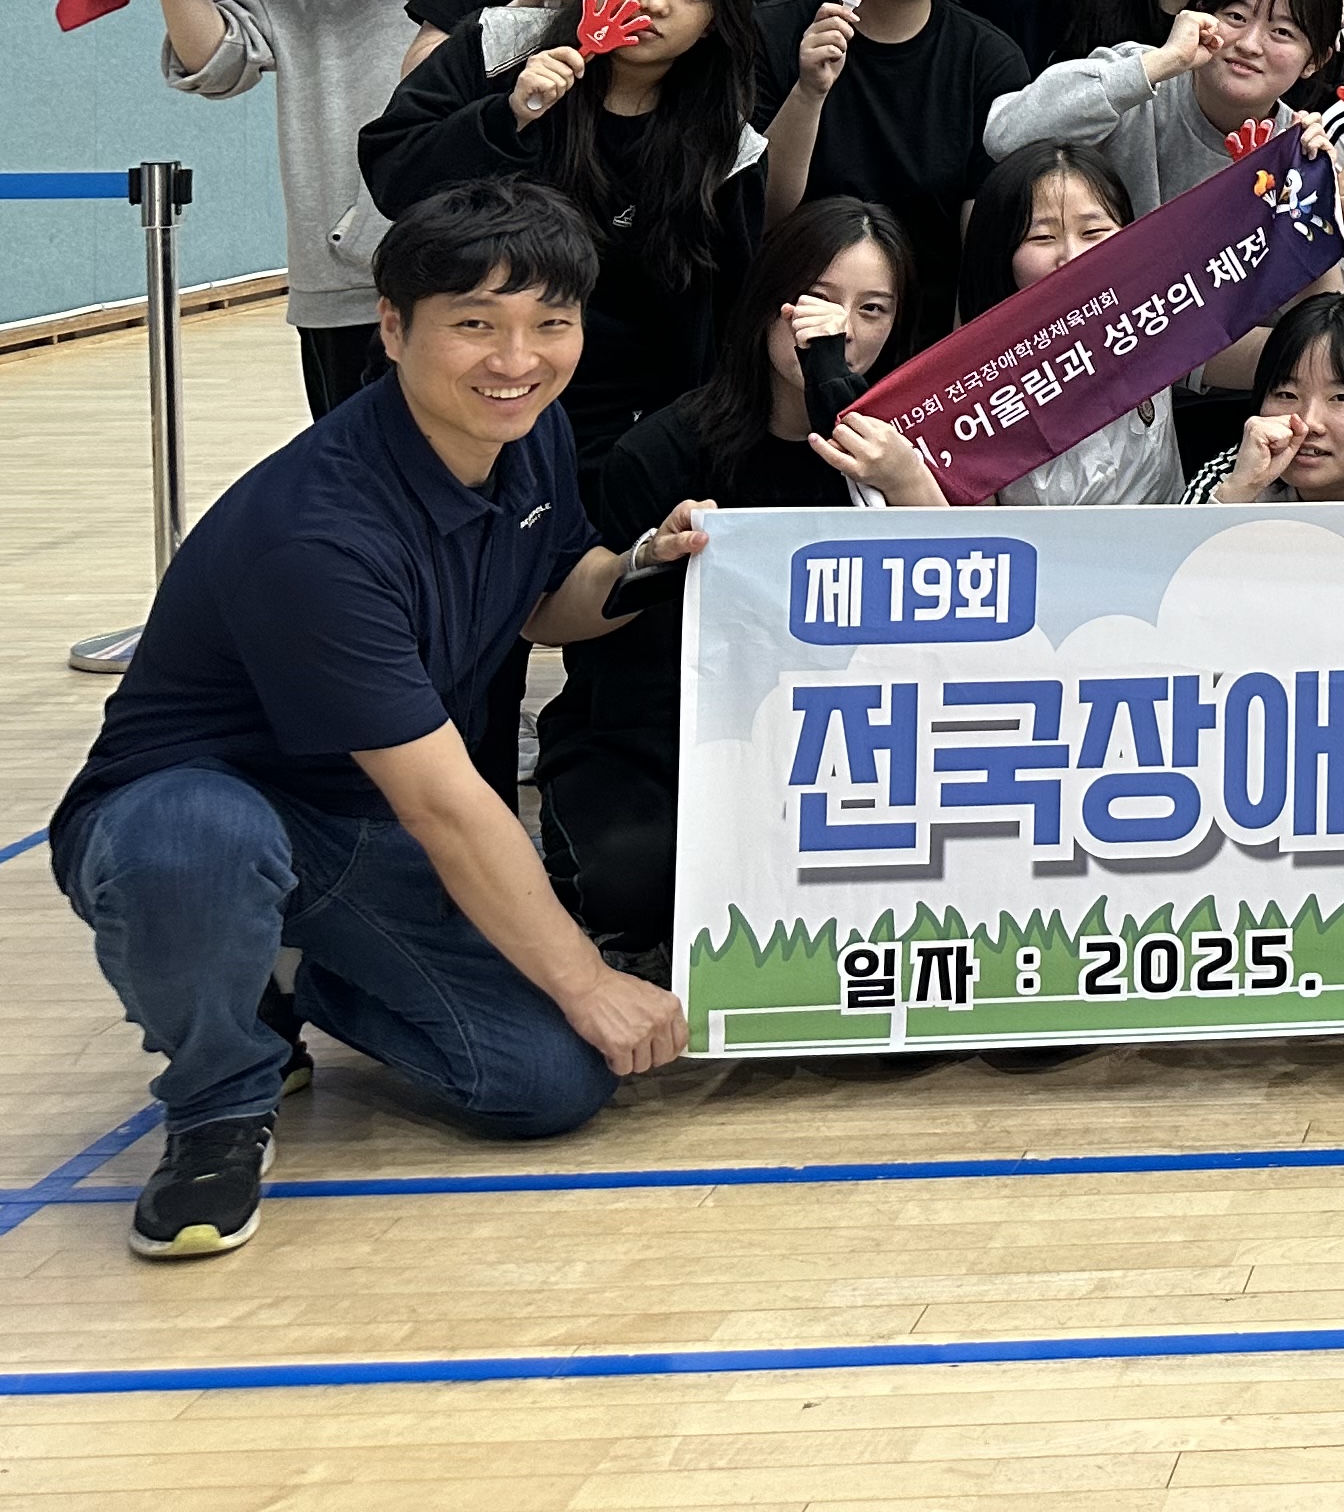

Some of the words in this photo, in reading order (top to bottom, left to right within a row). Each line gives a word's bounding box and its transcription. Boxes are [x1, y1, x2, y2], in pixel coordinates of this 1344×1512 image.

[945, 287, 1120, 404] 전국장애학생체육대회
[953, 339, 1097, 443] 어울림과
[1102, 272, 1206, 357] 성장의
[1205, 226, 1271, 290] 체전
[804, 557, 863, 628] 제
[882, 550, 1010, 624] 19회
[843, 946, 974, 1009] 일자
[1083, 932, 1318, 997] 2025.
